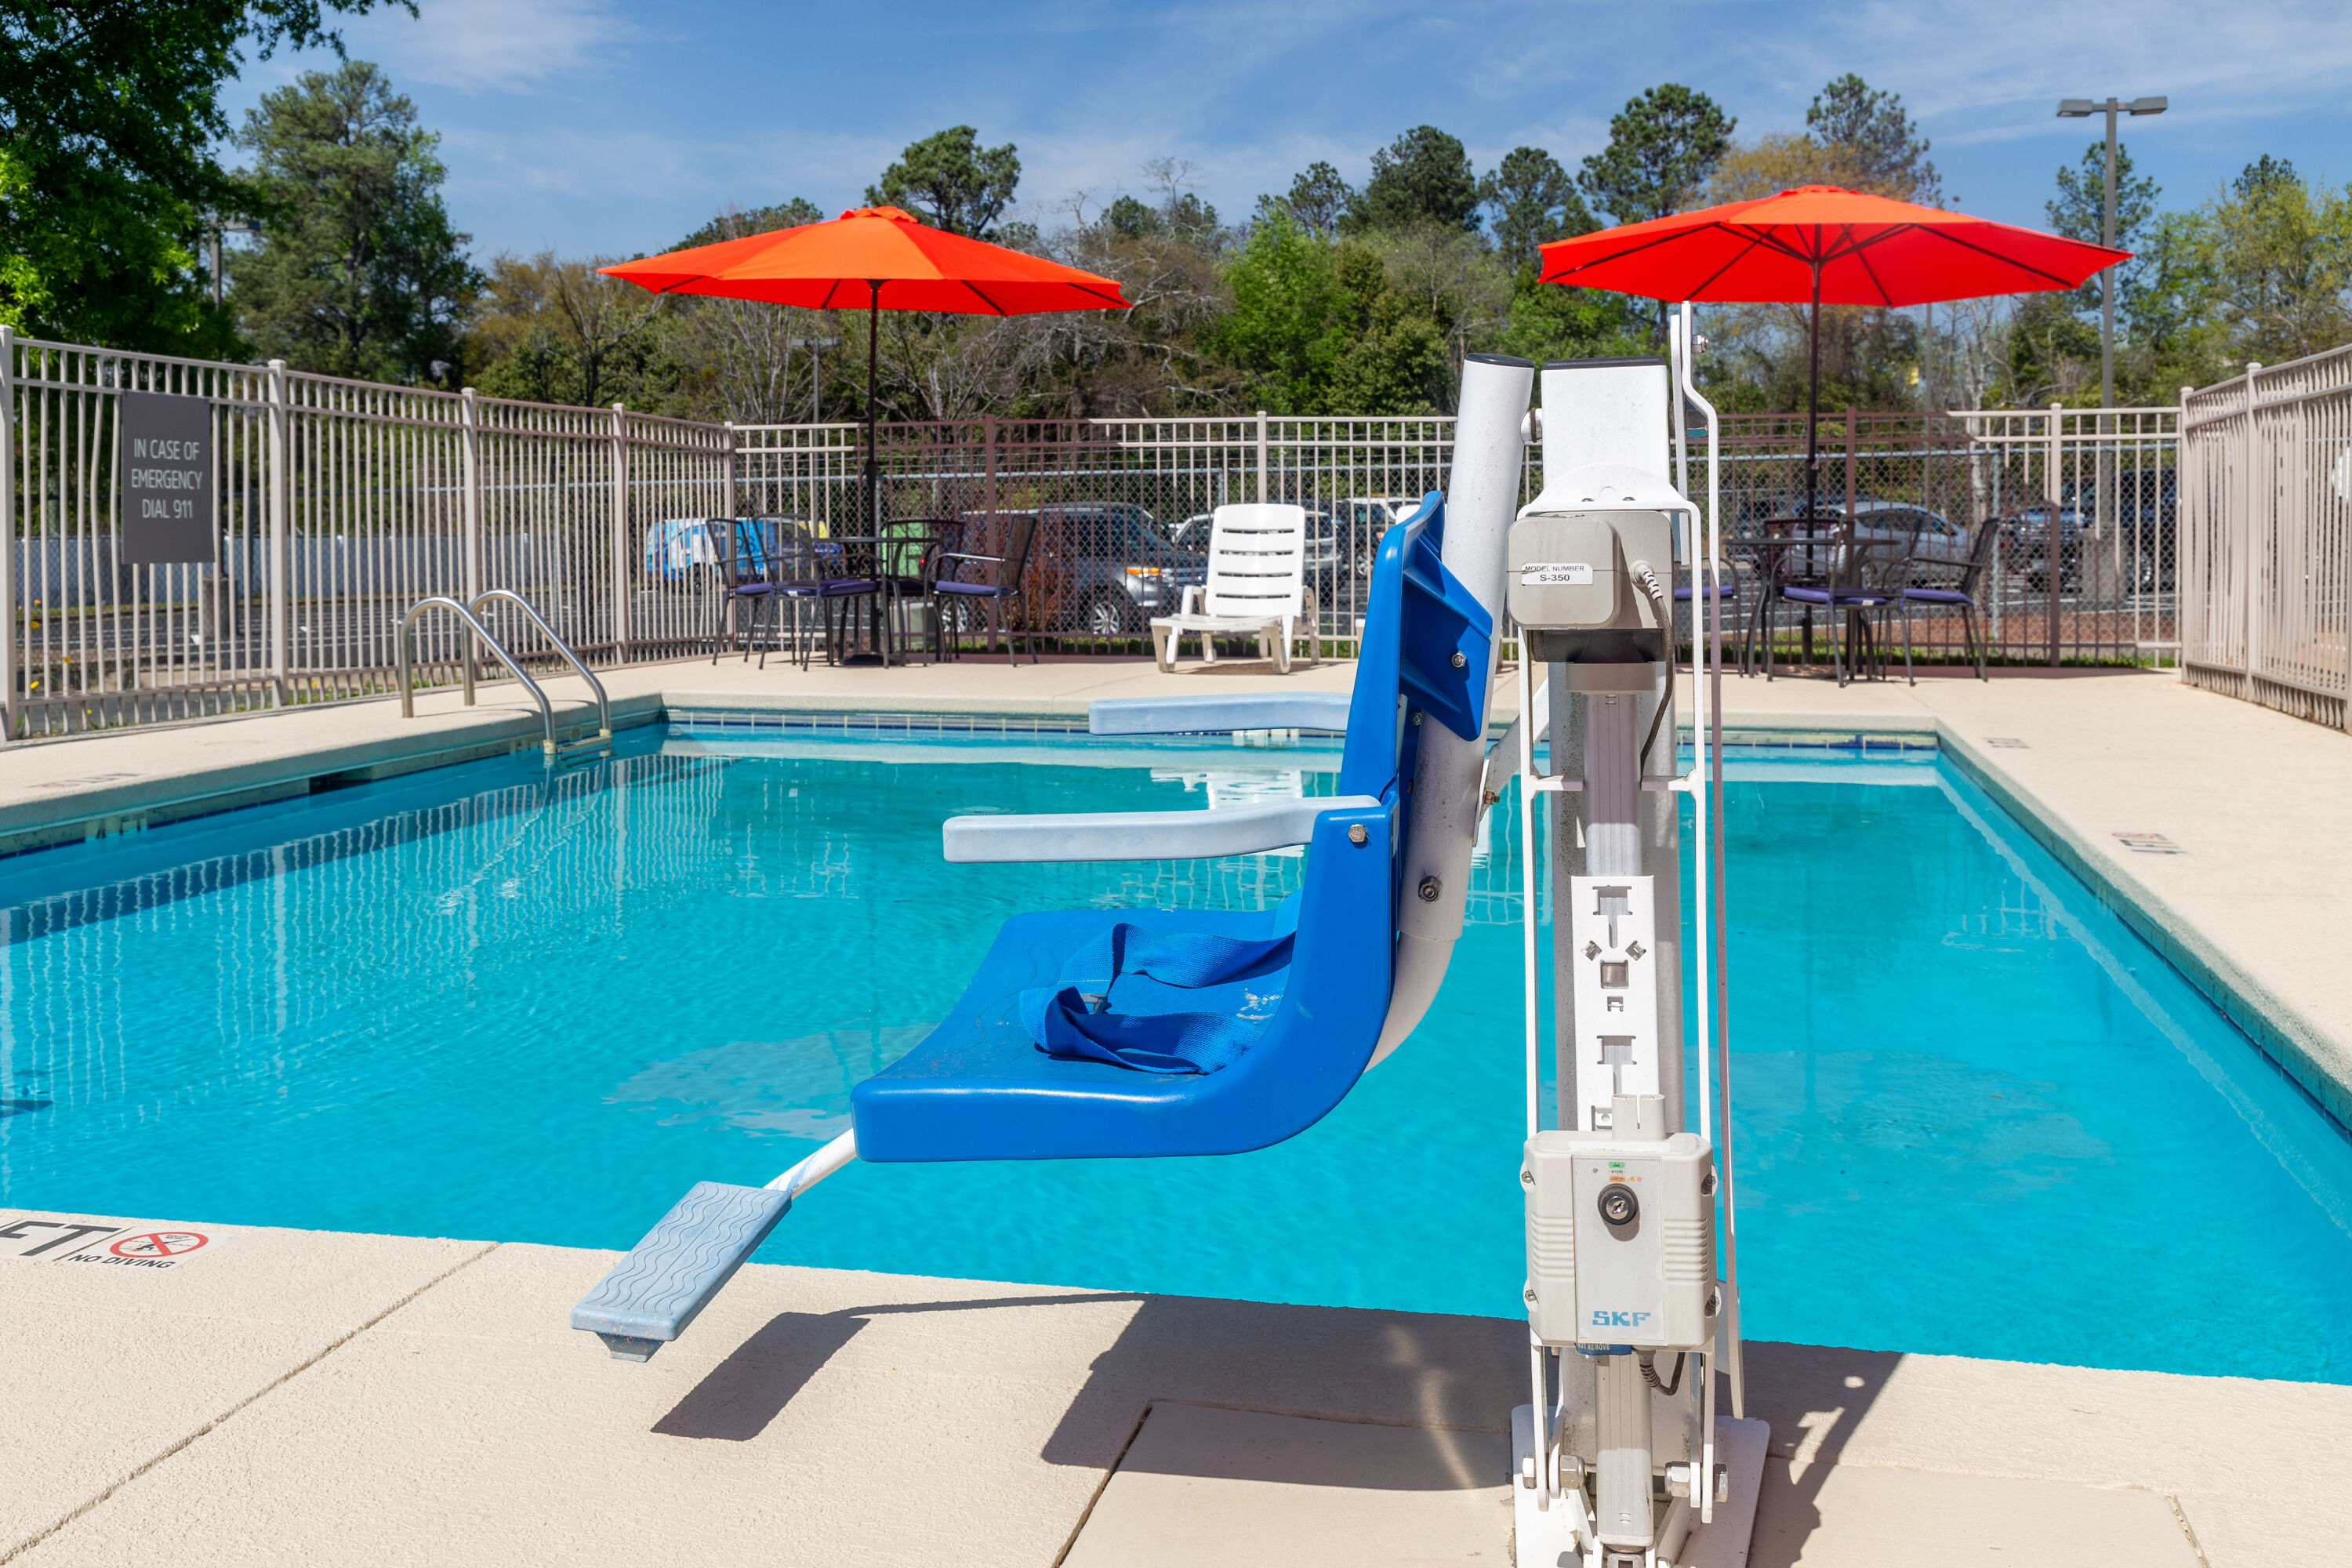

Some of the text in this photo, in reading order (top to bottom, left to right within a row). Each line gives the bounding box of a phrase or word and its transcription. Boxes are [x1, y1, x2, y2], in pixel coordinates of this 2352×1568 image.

[134, 437, 200, 461] IN CASE OF
[131, 468, 203, 490] EMERGENCY
[142, 499, 193, 519] DIAL 911
[1540, 574, 1570, 583] S-350
[102, 1257, 176, 1269] DIVING
[1592, 1311, 1651, 1327] SKF
